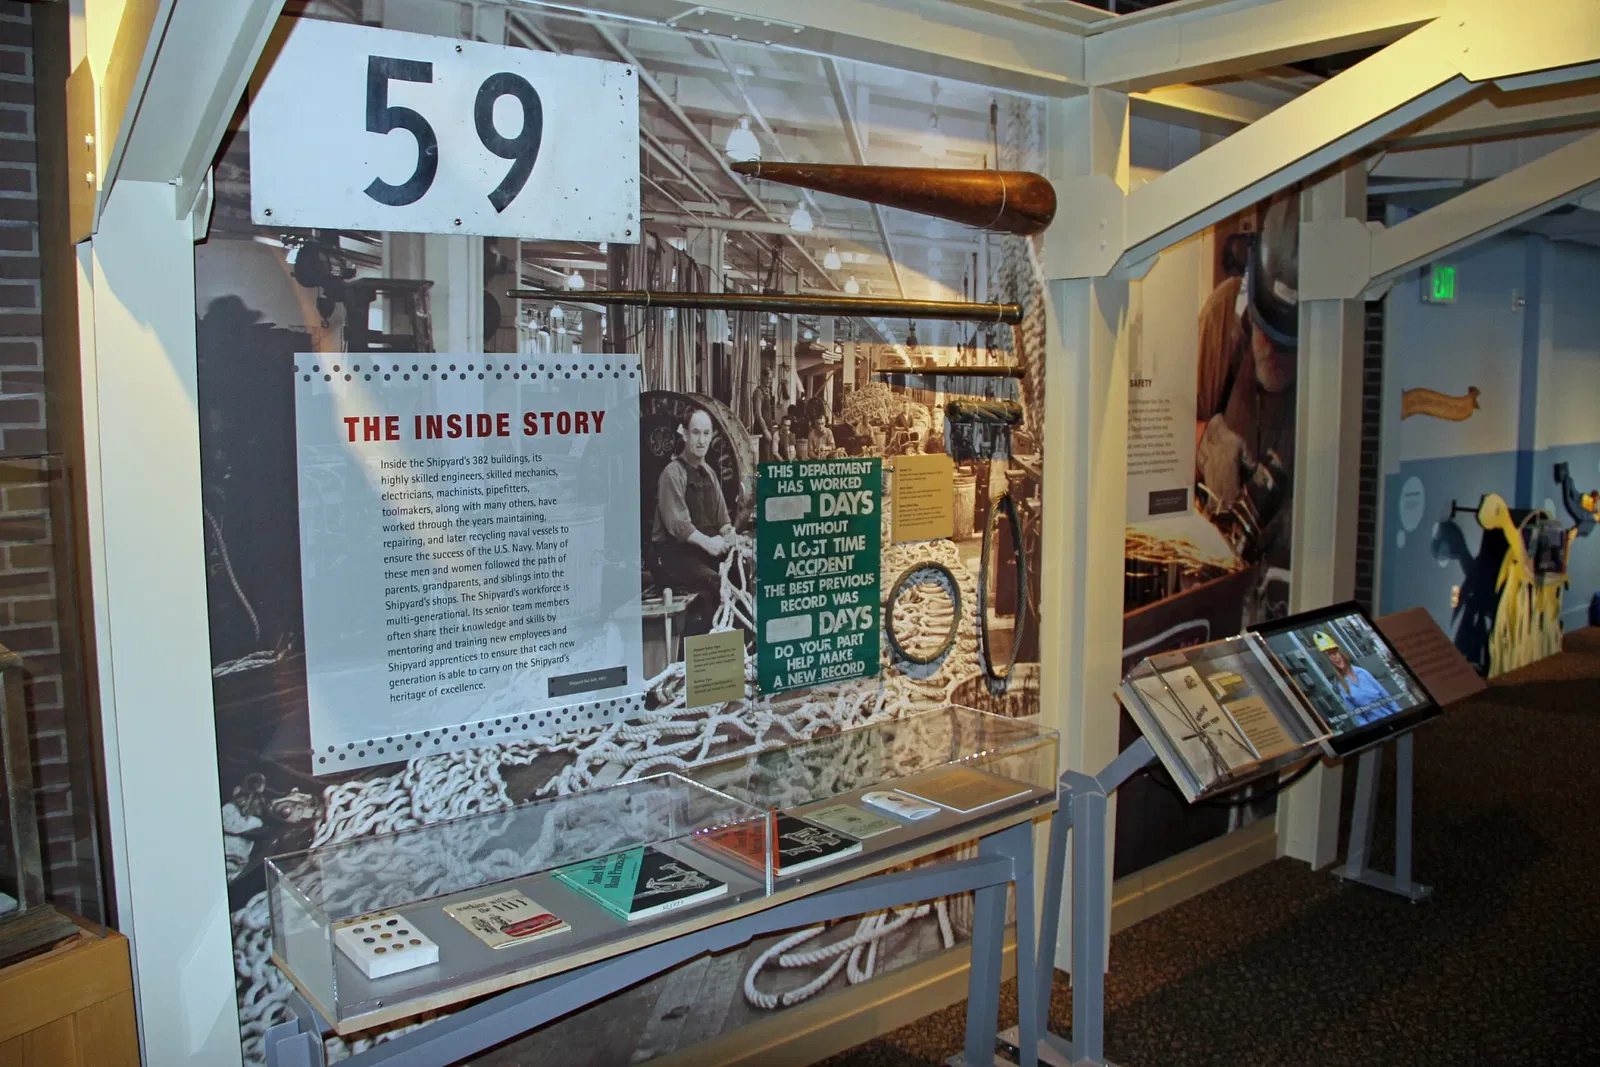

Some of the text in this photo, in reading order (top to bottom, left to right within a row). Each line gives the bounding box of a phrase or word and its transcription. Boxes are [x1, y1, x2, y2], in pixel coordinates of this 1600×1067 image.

[364, 55, 543, 213] 59
[344, 410, 606, 442] THE INSIDE STORY
[380, 452, 542, 469] Inside the Shipyard's 382 buildings, its
[768, 462, 872, 478] THIS DEPARTMENT
[380, 466, 558, 488] highly skilled engineers, skilled mechanics,
[778, 478, 862, 493] HAS WORKED
[380, 483, 530, 501] electricians, machinists, pipefitters,
[819, 491, 874, 517] DAYS
[381, 497, 557, 517] toolmakers, along with many others, have
[382, 512, 547, 532] worked through the years maintaining,
[792, 520, 848, 537] WITHOUT
[382, 525, 569, 550] repairing, and later recycling naval vessels to
[774, 535, 866, 559] A LOST TIME
[383, 539, 568, 564] ensure the success of the U.S. Navy. Many of
[383, 554, 567, 580] these men and women followed the path of
[786, 555, 855, 577] ACCIDENT
[384, 569, 565, 597] parents, grandparents, and siblings into the
[764, 573, 874, 598] THE BEST PREVIOUS
[384, 583, 570, 611] Shipyard's shops. The Shipyard's workforce is
[780, 591, 859, 613] RECORD WAS
[385, 598, 570, 626] multi-generational. Its senior team members
[819, 606, 873, 636] DAYS
[386, 613, 557, 642] often share their knowledge and skills by
[387, 625, 567, 656] mentoring and training new employees and
[774, 633, 864, 660] DO YOUR PART
[387, 640, 575, 673] Shipyard apprentices to ensure that each new
[786, 649, 853, 671] HELP MAKE
[388, 653, 570, 690] generation is able to carry on the Shipyard's
[773, 661, 866, 688] A NEW RECORD
[389, 682, 486, 703] heritage of excellence.
